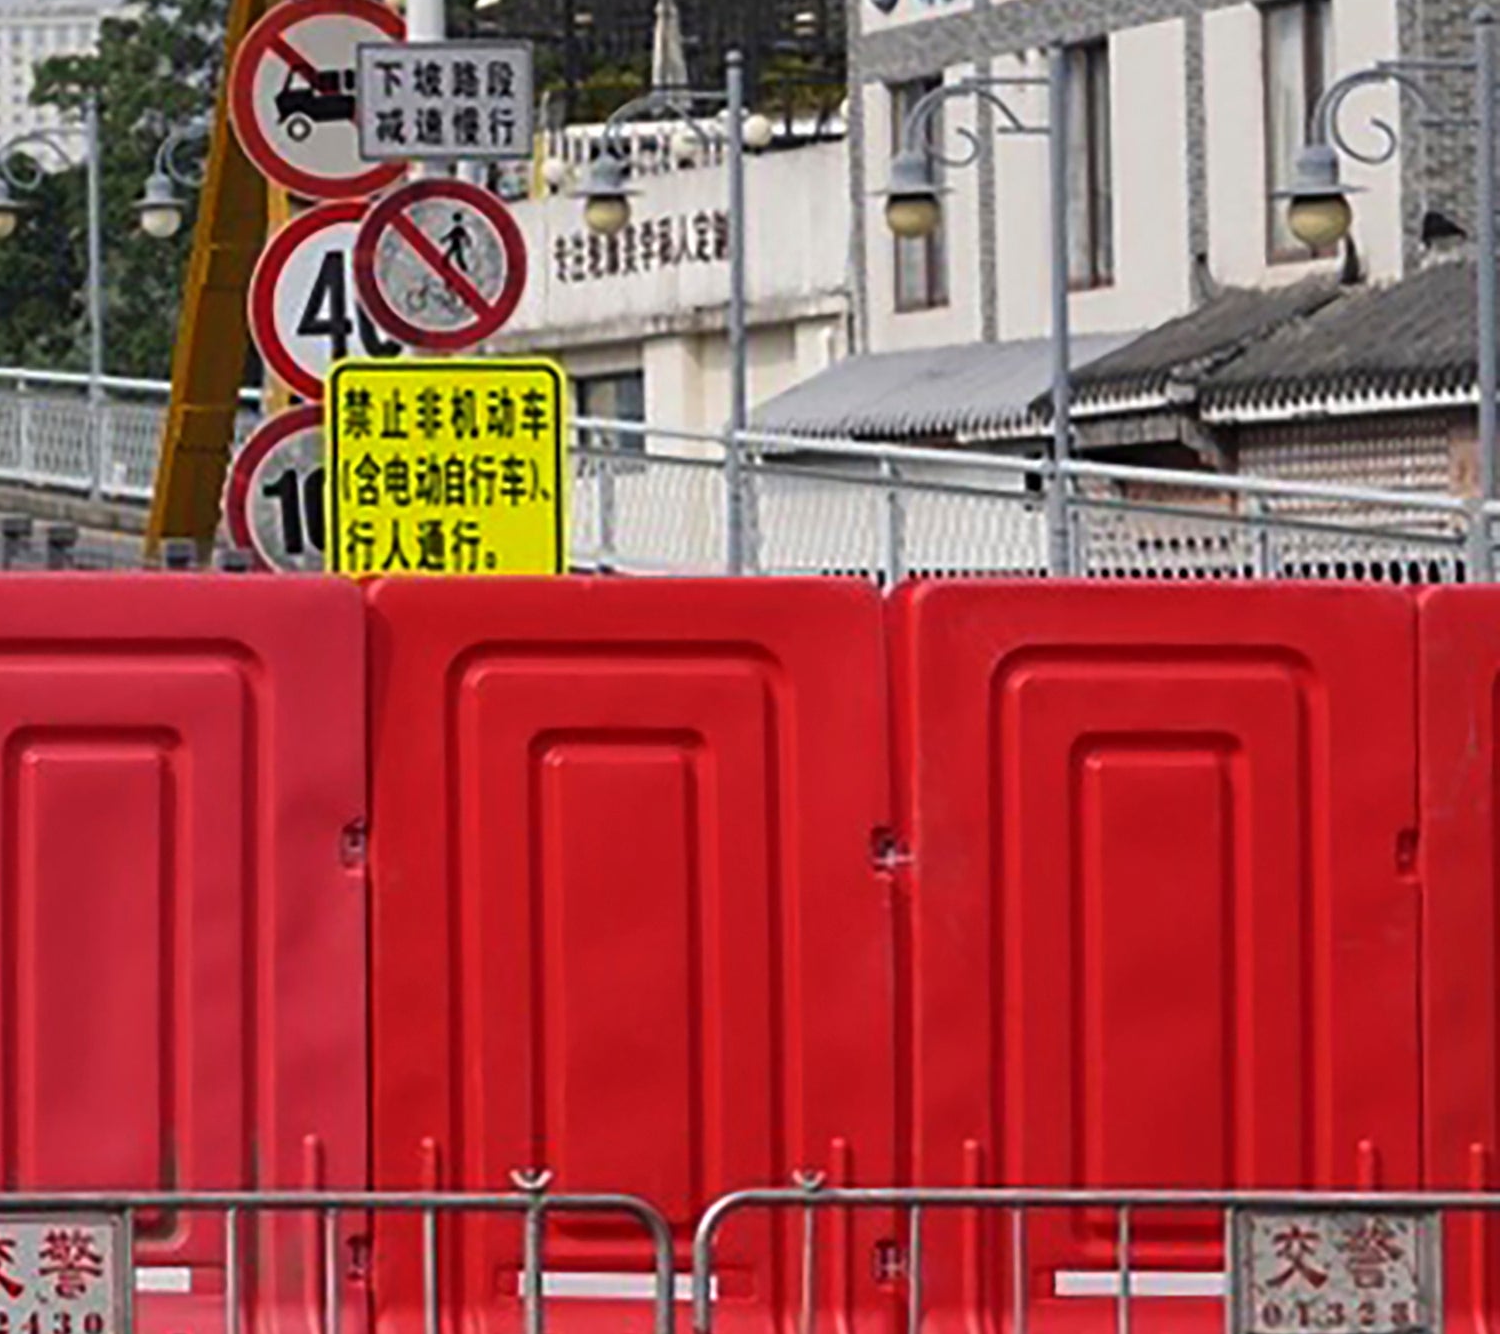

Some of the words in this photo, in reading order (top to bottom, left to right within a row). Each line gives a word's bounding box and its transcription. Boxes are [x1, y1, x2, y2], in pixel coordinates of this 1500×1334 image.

[374, 60, 515, 98] 下坡路段
[375, 106, 515, 146] 减速慢行
[343, 387, 549, 440] 禁止非机动车
[1266, 1218, 1405, 1289] 交警
